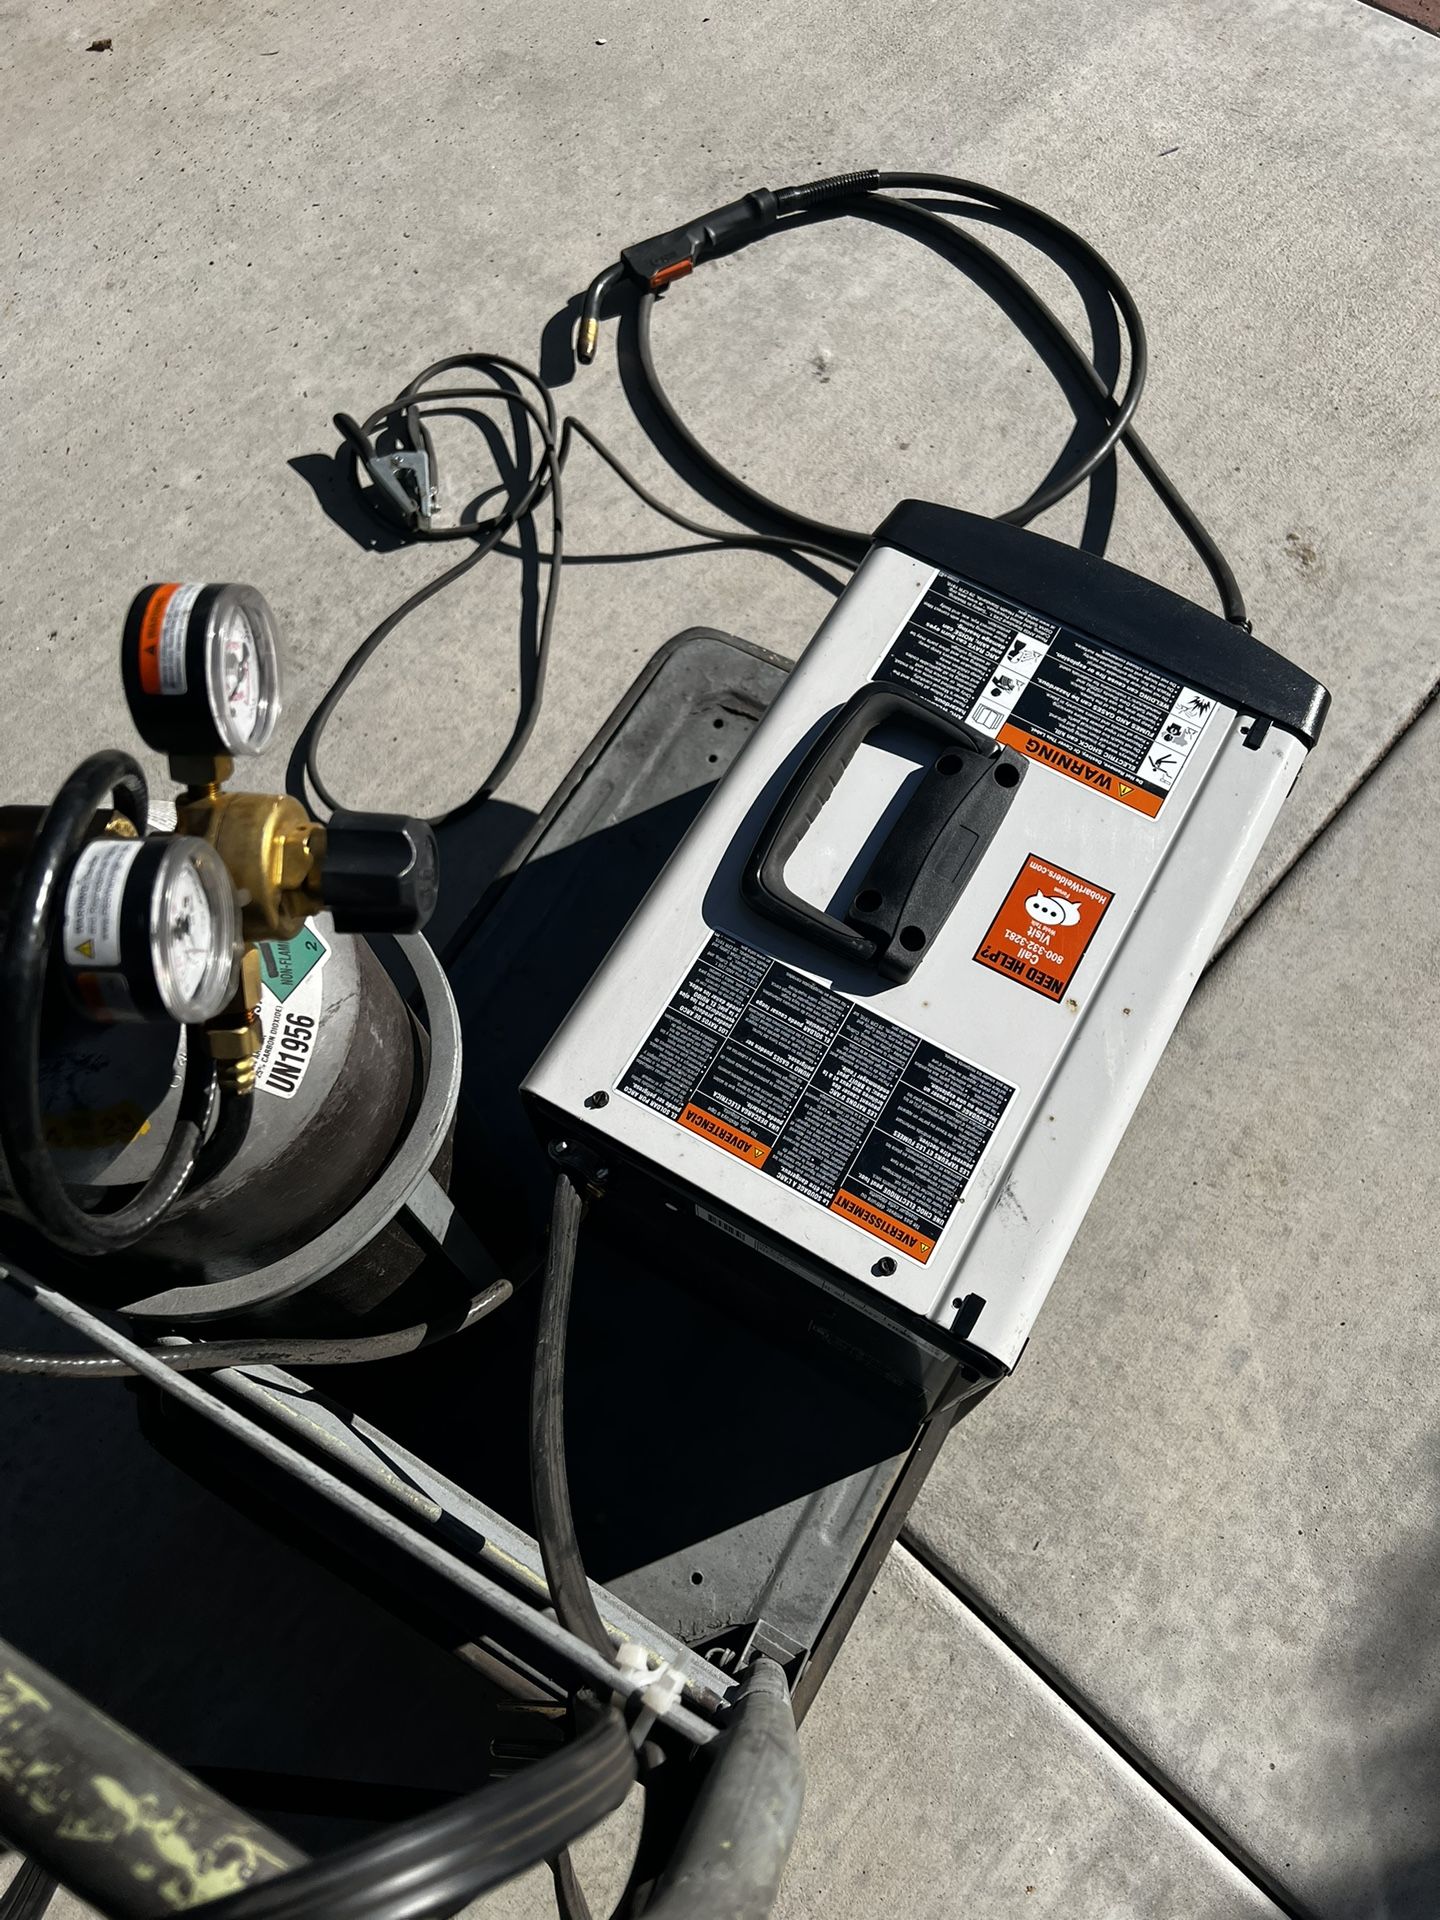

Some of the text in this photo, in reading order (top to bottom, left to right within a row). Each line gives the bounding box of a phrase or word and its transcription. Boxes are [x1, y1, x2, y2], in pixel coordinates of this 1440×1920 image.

[925, 621, 1000, 661] ARC RAYS can burn eyes
[941, 622, 1003, 655] and skin; NOISE can
[956, 622, 1006, 650] damage hearing.
[1055, 651, 1087, 670] explosion.
[1094, 670, 1107, 680] fire
[1106, 675, 1126, 688] cause
[1125, 684, 1139, 694] can
[932, 694, 967, 715] hazardous.
[1036, 676, 1155, 738] FUMES AND GASES can be hazardous.
[1138, 691, 1170, 710] WELDING
[1030, 726, 1046, 737] Label.
[1045, 733, 1057, 743] This
[1053, 726, 1136, 771] ELECTRIC SHOCK can kill.
[1056, 739, 1073, 751] Cover
[1024, 737, 1112, 791] WARNING
[1081, 750, 1103, 765] Destroy,
[1102, 760, 1125, 776] Remove,
[1124, 772, 1136, 781] Not
[1134, 777, 1144, 785] Do
[1029, 861, 1107, 905] HobartWelders.com
[1053, 886, 1071, 899] Forum
[1027, 926, 1051, 945] Visit
[1031, 919, 1056, 936] Weld Talk
[305, 940, 318, 952] 2
[1004, 928, 1064, 965] 800-332-3281
[279, 941, 293, 986] NON-FLAM
[1018, 947, 1039, 965] Call
[980, 945, 1064, 994] NEED HELP?
[689, 995, 698, 1004] los
[692, 990, 710, 1004] RUIDO
[702, 988, 712, 997] los
[709, 999, 717, 1008] EL
[716, 1002, 729, 1013] piel;
[724, 1001, 743, 1013] puede
[678, 1004, 729, 1035] LOS RAYOS DE ARCO
[691, 1004, 733, 1029] pueden producir
[704, 1003, 736, 1024] quemaduras
[727, 1009, 735, 1017] la
[754, 998, 831, 1044] EL SOLDAR puede causar fuego
[261, 1034, 276, 1064] CARBON
[270, 1005, 283, 1035] DIOXIDE)
[266, 1013, 315, 1093] UN1956
[744, 1038, 811, 1079] HUMO Y GASES pueden ser
[786, 1053, 815, 1072] peligrosos.
[821, 1068, 829, 1077] la
[827, 1071, 833, 1079] à
[831, 1074, 840, 1082] et
[835, 1069, 888, 1100] peau; le BRUIT peut
[838, 1078, 852, 1089] yeux
[851, 1084, 862, 1094] aux
[855, 1073, 890, 1095] endommager
[622, 1085, 678, 1119] EL SOLDAR POR ARCO
[631, 1081, 682, 1113] puede ser peligroso.
[828, 1087, 878, 1118] LES RAYONS D'ARC
[830, 1081, 882, 1112] peuvent causer des
[929, 1081, 998, 1123] incendie ou une explosion.
[740, 1105, 769, 1126] DESCARGA
[745, 1100, 784, 1126] puede matarlo.
[922, 1085, 995, 1129] LE SOUDAGE peut causer un
[684, 1109, 752, 1153] ADVERTENCIA
[767, 1121, 780, 1132] UNA
[914, 1141, 927, 1152] LES
[924, 1148, 934, 1156] ET
[932, 1152, 959, 1171] VAPEURS
[950, 1153, 974, 1170] peuvent
[775, 1171, 793, 1185] L'ARC
[779, 1164, 809, 1185] dangereux.
[857, 1171, 871, 1184] tuer.
[958, 1166, 970, 1176] LES
[795, 1182, 823, 1202] SOUDAGE
[818, 1187, 834, 1199] peut
[869, 1179, 884, 1190] peut
[833, 1194, 918, 1248] AVERTISSEMENT
[915, 1205, 933, 1219] CHOC
[931, 1214, 945, 1226] UNE
